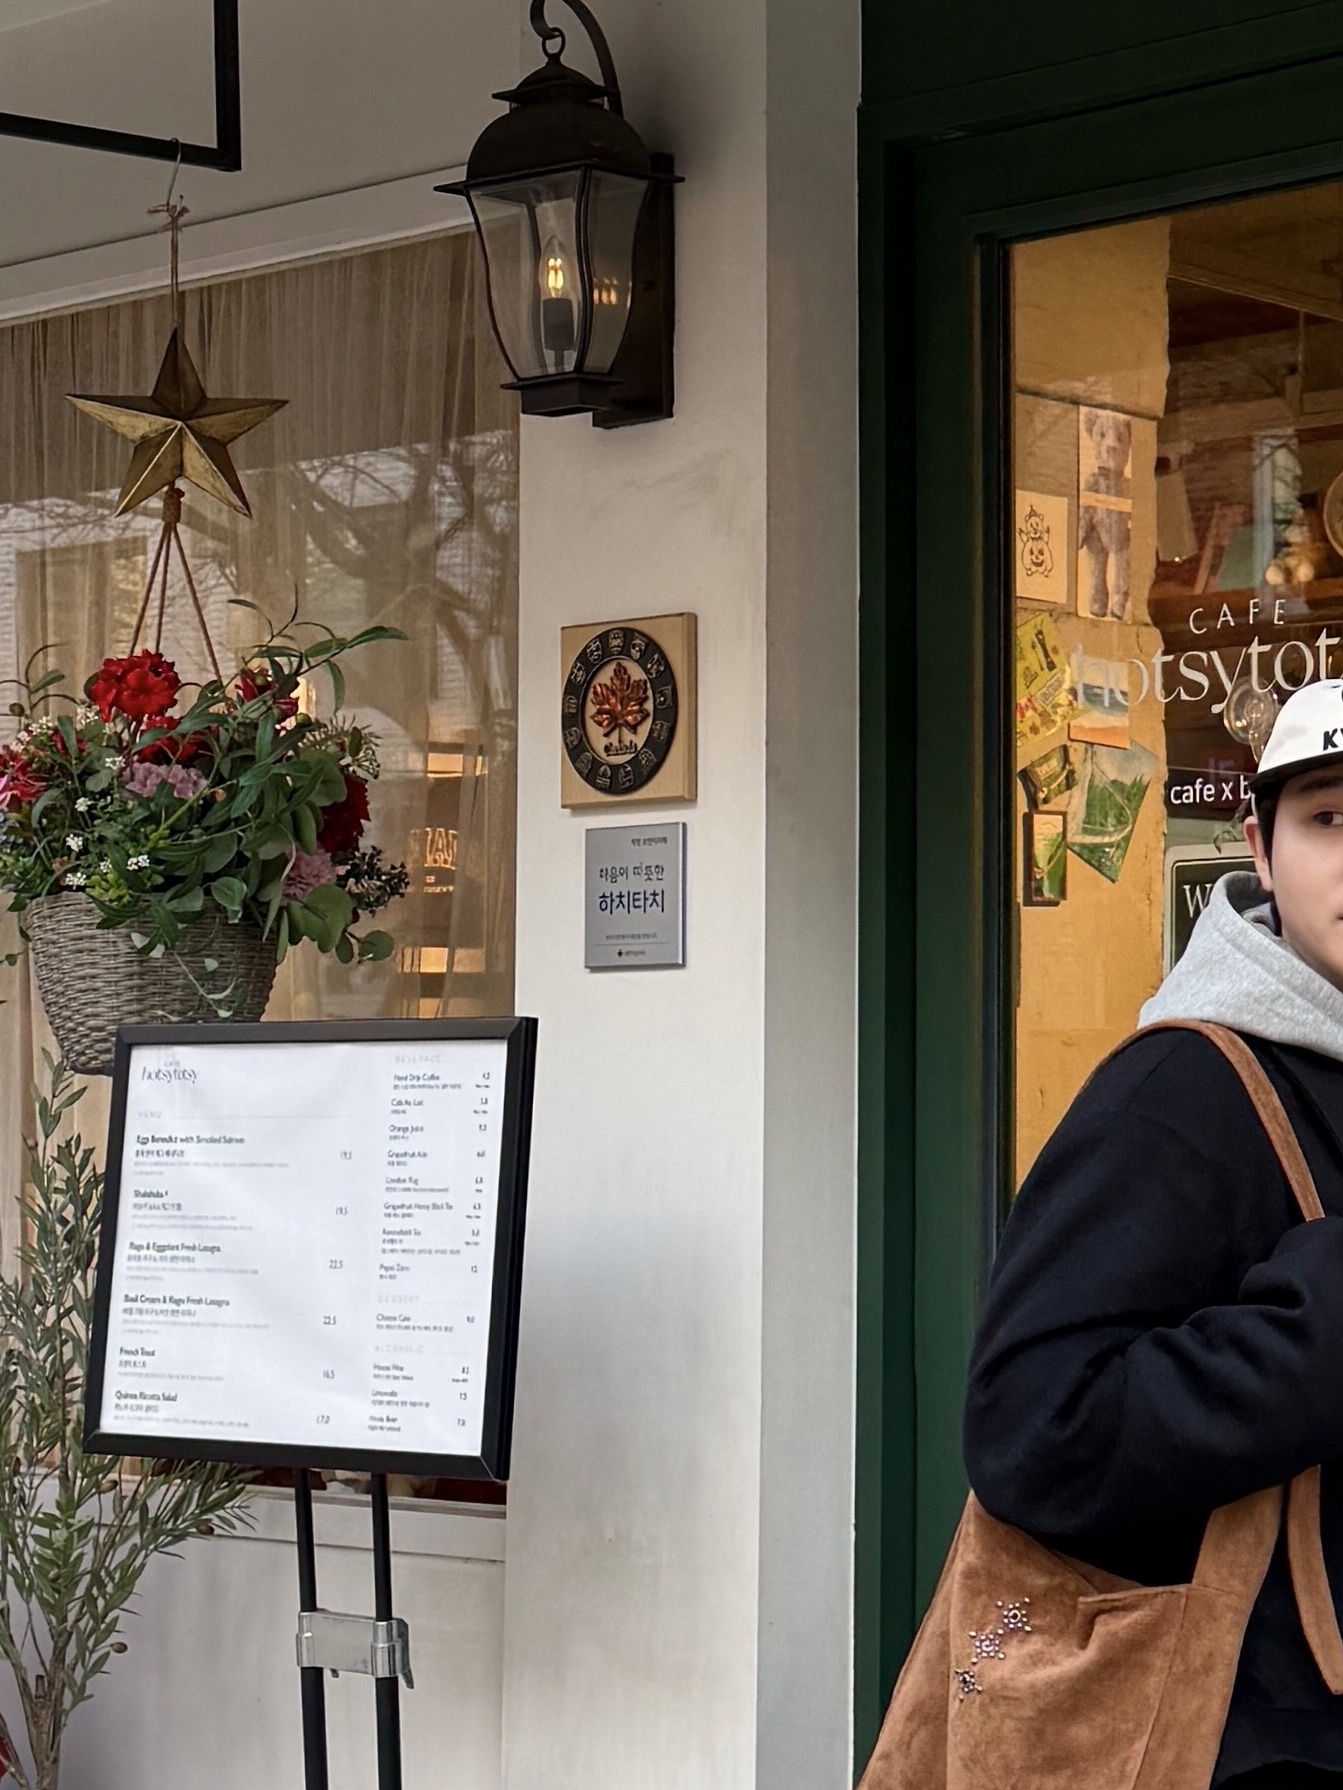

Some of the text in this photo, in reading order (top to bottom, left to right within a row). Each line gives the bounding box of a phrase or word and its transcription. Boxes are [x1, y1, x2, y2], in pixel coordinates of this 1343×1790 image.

[1189, 598, 1286, 635] CAFE
[1170, 777, 1216, 804] cafe
[1222, 781, 1233, 801] x
[599, 888, 665, 915] 하치타치
